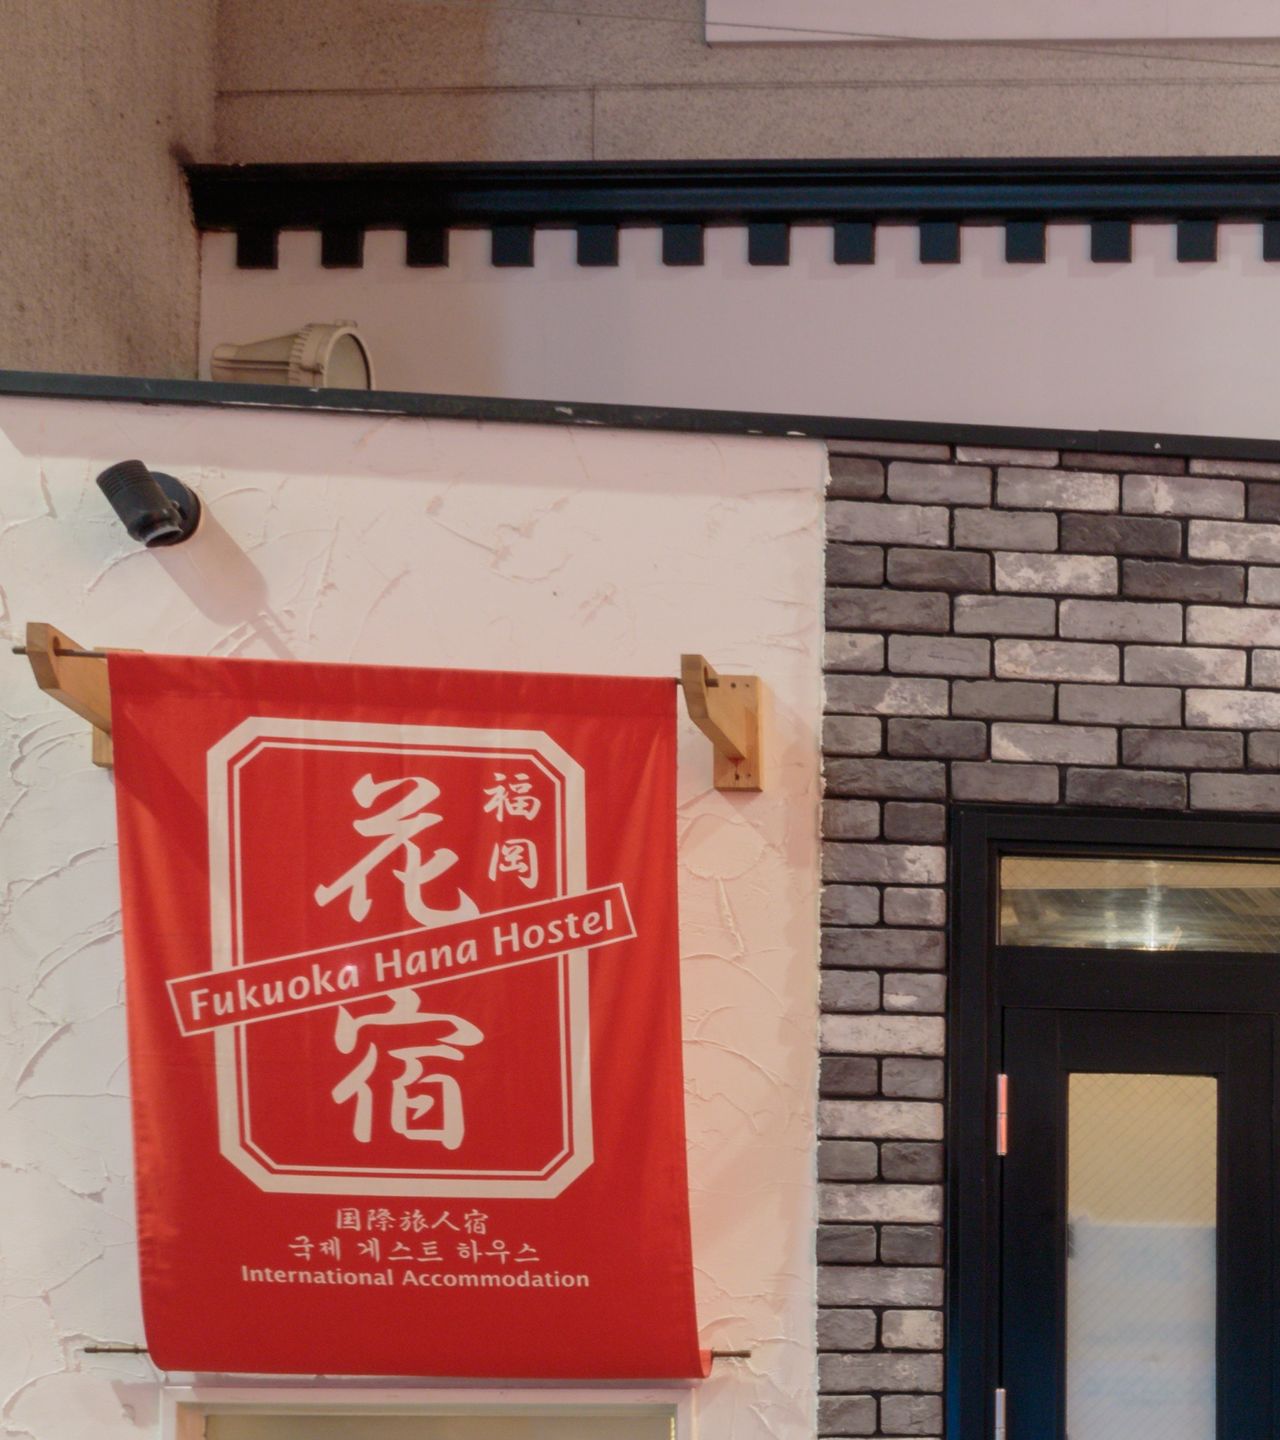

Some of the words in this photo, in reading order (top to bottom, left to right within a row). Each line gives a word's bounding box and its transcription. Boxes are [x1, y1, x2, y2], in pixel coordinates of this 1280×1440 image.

[483, 772, 542, 889] 福岡
[189, 963, 360, 1021] Fukuoka
[374, 938, 479, 983] Hana
[493, 899, 616, 956] Hostel
[336, 1207, 490, 1235] 国際旅人宿
[288, 1236, 342, 1261] 국제
[357, 1237, 444, 1263] 게스트
[456, 1240, 541, 1265] 하우스
[241, 1265, 394, 1287] International
[402, 1270, 591, 1288] Accommodation
